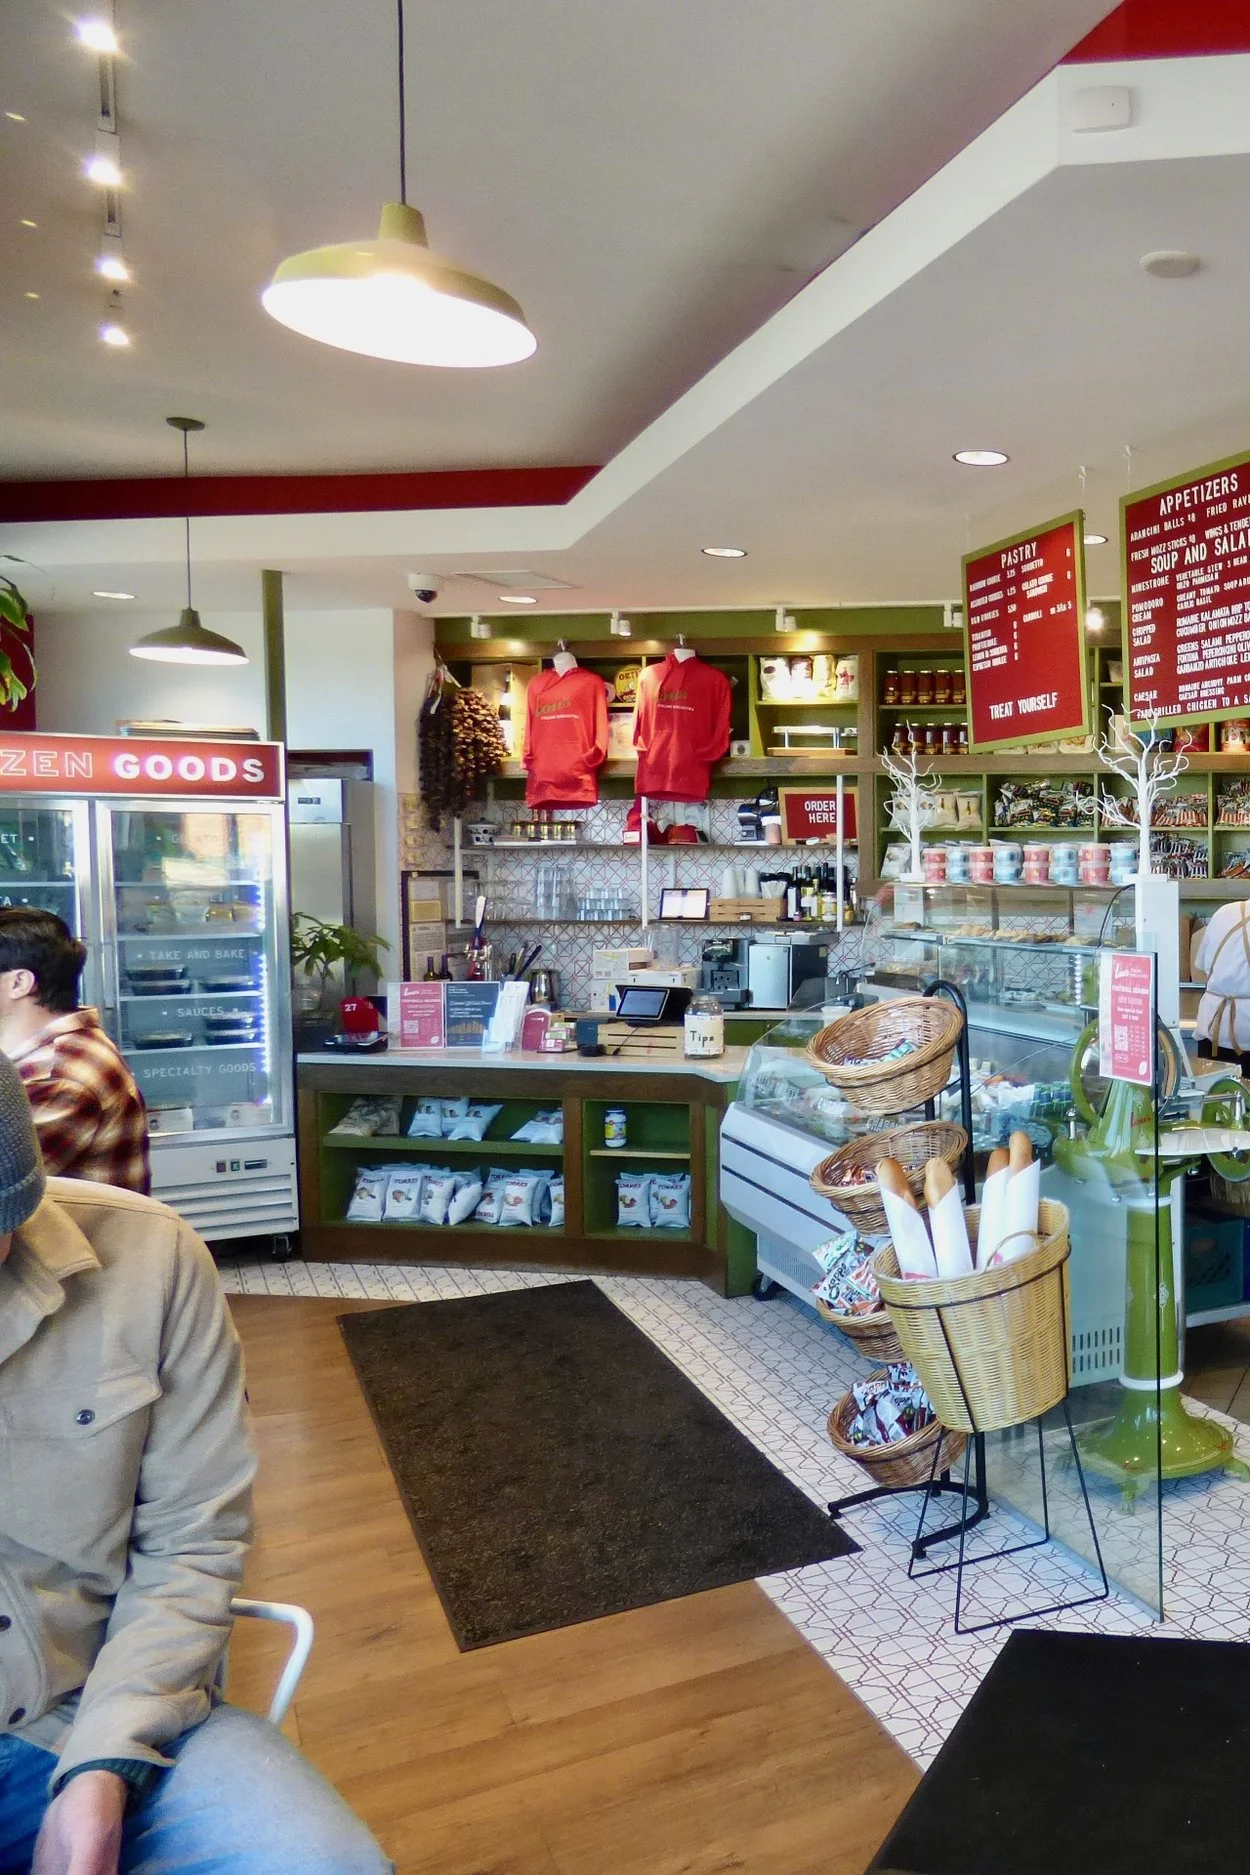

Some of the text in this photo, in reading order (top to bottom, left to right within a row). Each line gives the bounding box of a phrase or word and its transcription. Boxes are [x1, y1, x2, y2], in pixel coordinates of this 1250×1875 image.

[1159, 473, 1239, 516] APPETIZERS
[1000, 541, 1038, 569] PASTRY
[1150, 553, 1179, 575] SOUP
[1184, 543, 1207, 567] AND
[989, 691, 1058, 720] TREAT YOURSELF
[1222, 692, 1232, 708] TO
[1234, 694, 1240, 705] A
[0, 749, 265, 783] ZEN GOODS
[803, 800, 836, 813] ORDER
[808, 811, 836, 824] HERE
[149, 949, 246, 960] TAKE AND BAKE
[177, 1006, 224, 1018] SAUCES
[689, 1029, 715, 1046] Tips
[143, 1062, 256, 1079] SPECIALTY GOODS
